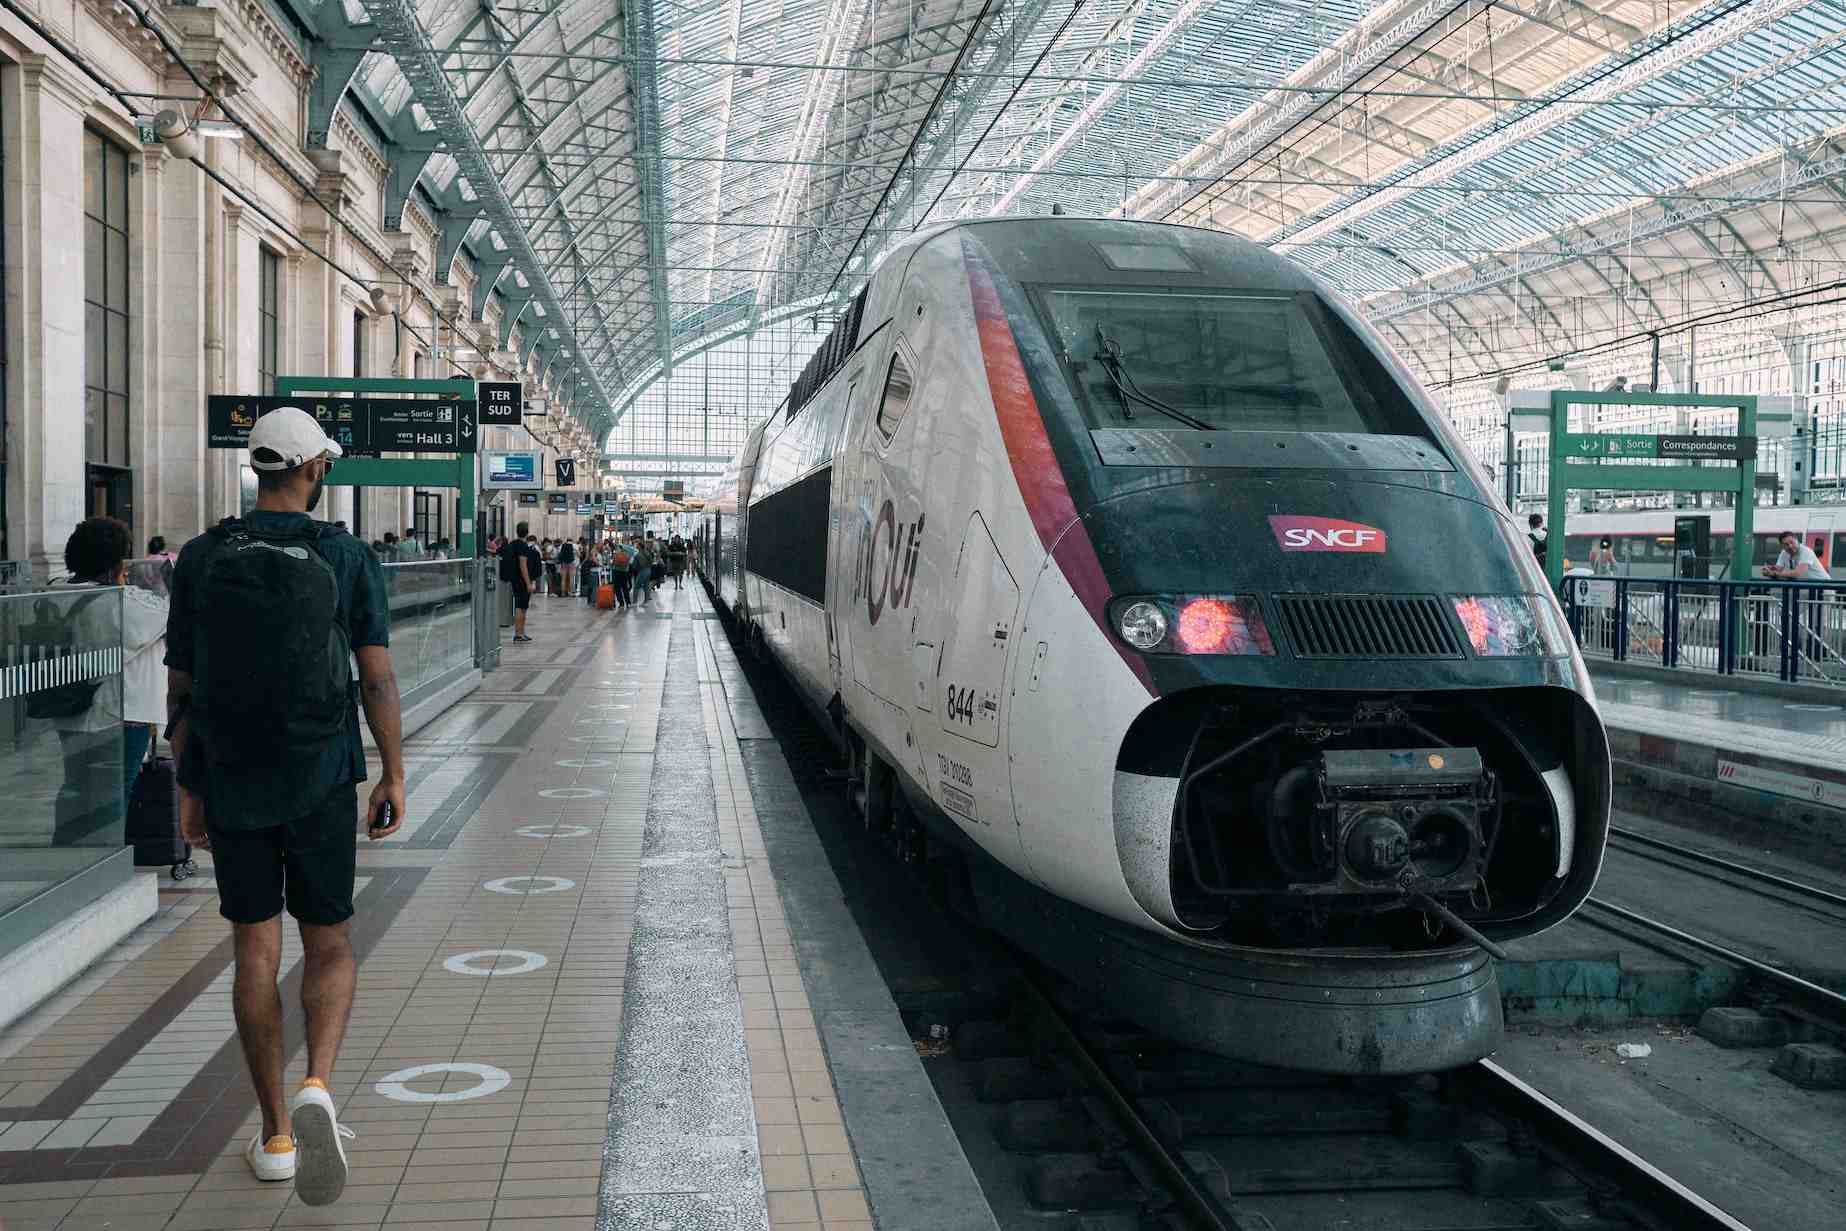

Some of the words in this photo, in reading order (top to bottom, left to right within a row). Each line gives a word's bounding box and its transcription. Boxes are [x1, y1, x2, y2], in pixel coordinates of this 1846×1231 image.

[489, 390, 511, 401] TER
[410, 408, 433, 418] Sortie
[487, 406, 512, 416] SUD
[416, 432, 442, 444] Hall
[445, 433, 453, 444] 3
[1626, 439, 1652, 449] Sortie
[1662, 439, 1737, 451] Correspondances
[558, 463, 571, 477] V
[1284, 528, 1377, 547] SNCF
[948, 684, 975, 726] 844
